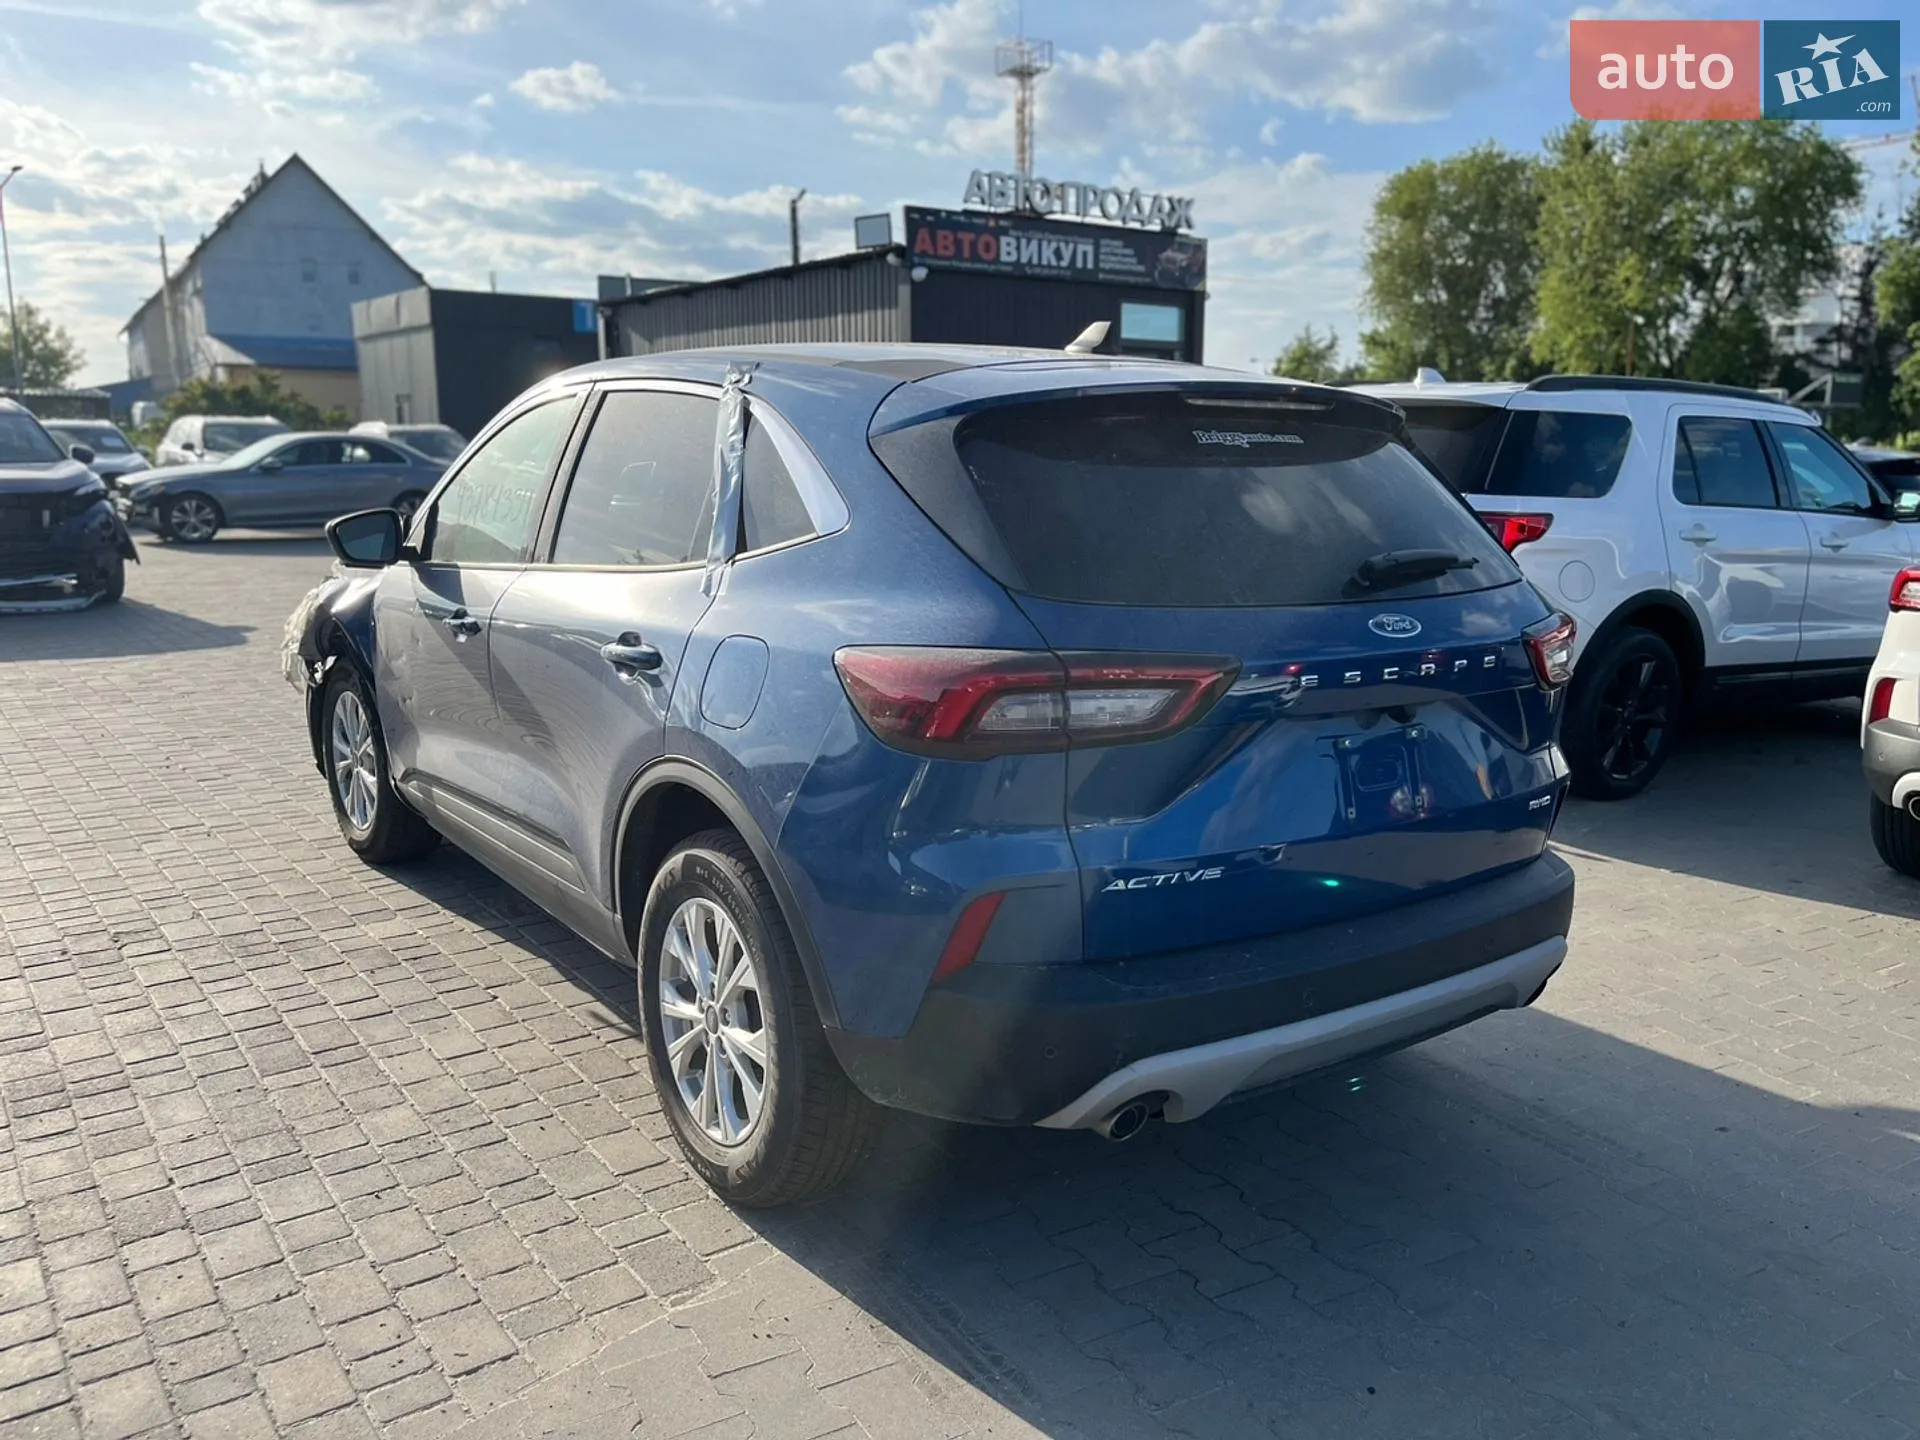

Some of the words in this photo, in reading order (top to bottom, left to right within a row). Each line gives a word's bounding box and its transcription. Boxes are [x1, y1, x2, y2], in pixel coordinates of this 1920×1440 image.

[963, 168, 1196, 231] АВТОПРОДАЖ
[1300, 654, 1496, 688] ESCAPE
[1100, 866, 1226, 893] ACTIVE
